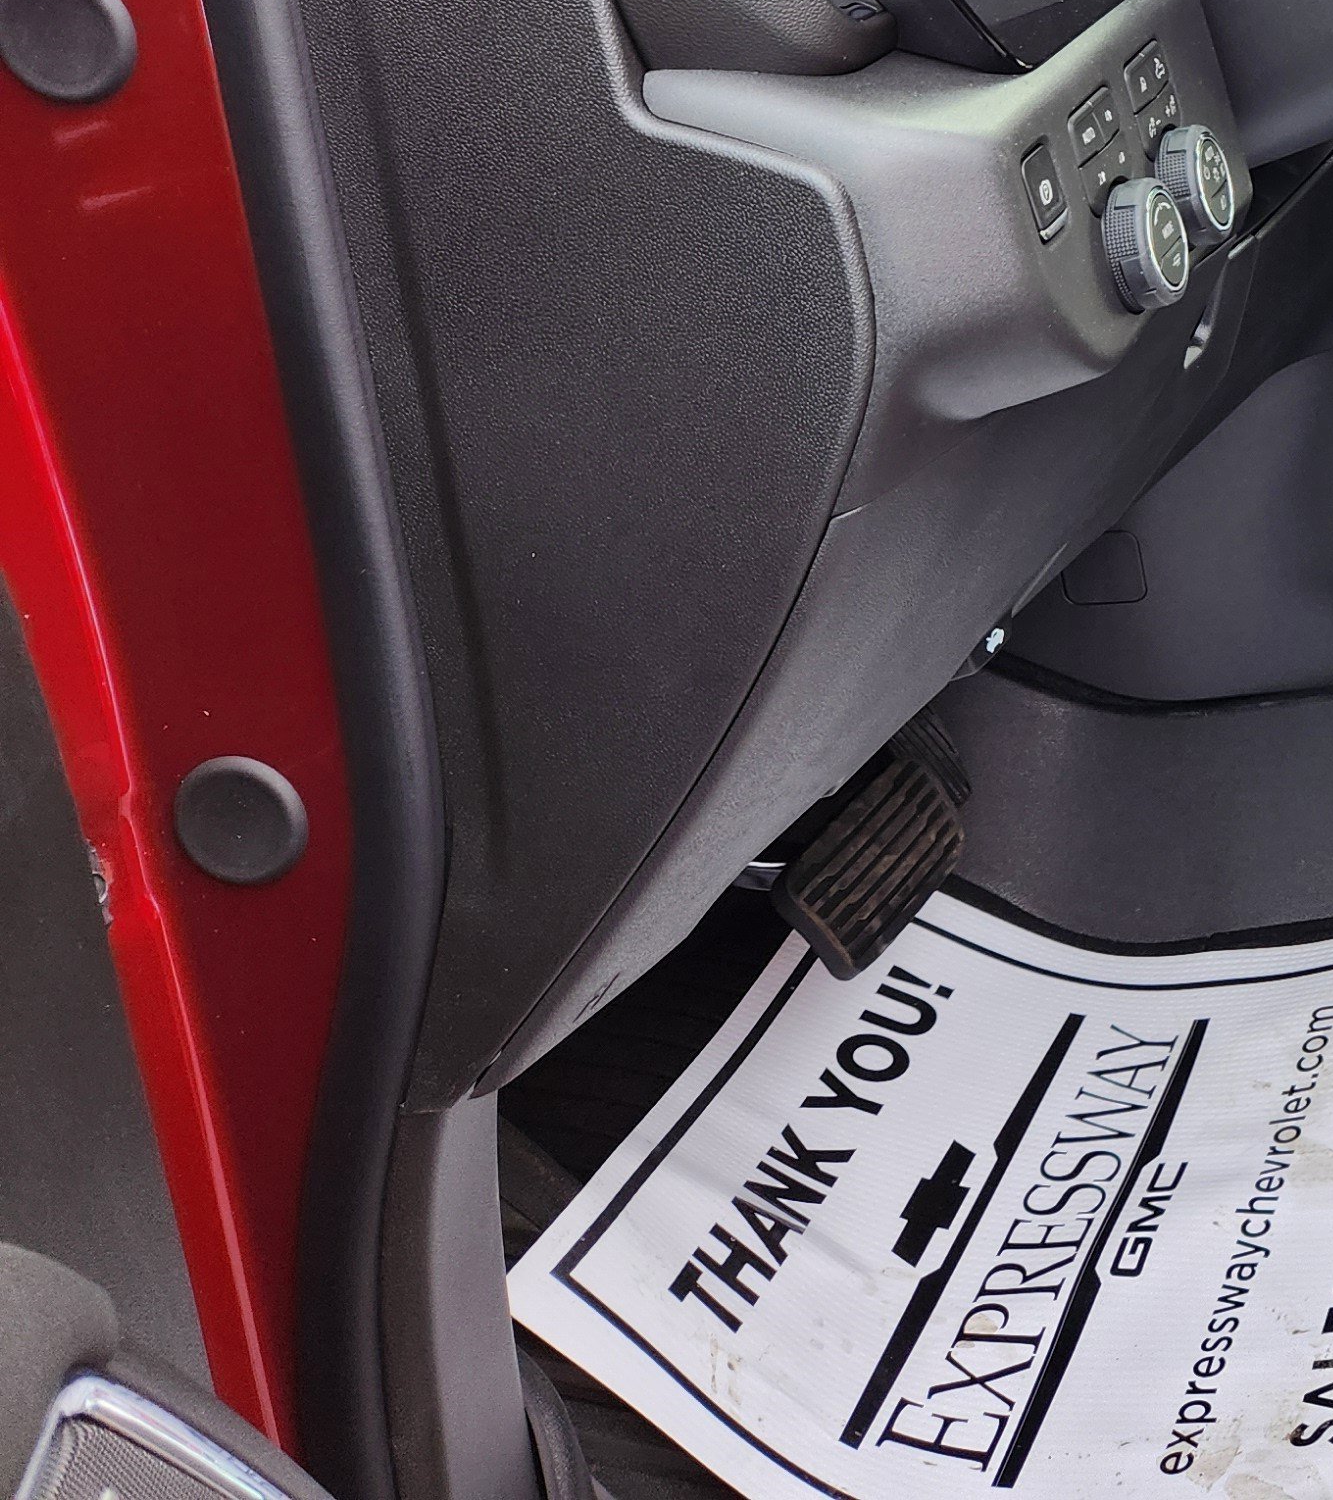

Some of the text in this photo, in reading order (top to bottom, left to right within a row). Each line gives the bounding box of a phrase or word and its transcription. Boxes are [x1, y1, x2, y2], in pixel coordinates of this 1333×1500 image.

[667, 964, 955, 1334] THANK YOU!
[875, 1024, 1179, 1473] EXPRESSWAY
[1109, 1161, 1189, 1277] GMC
